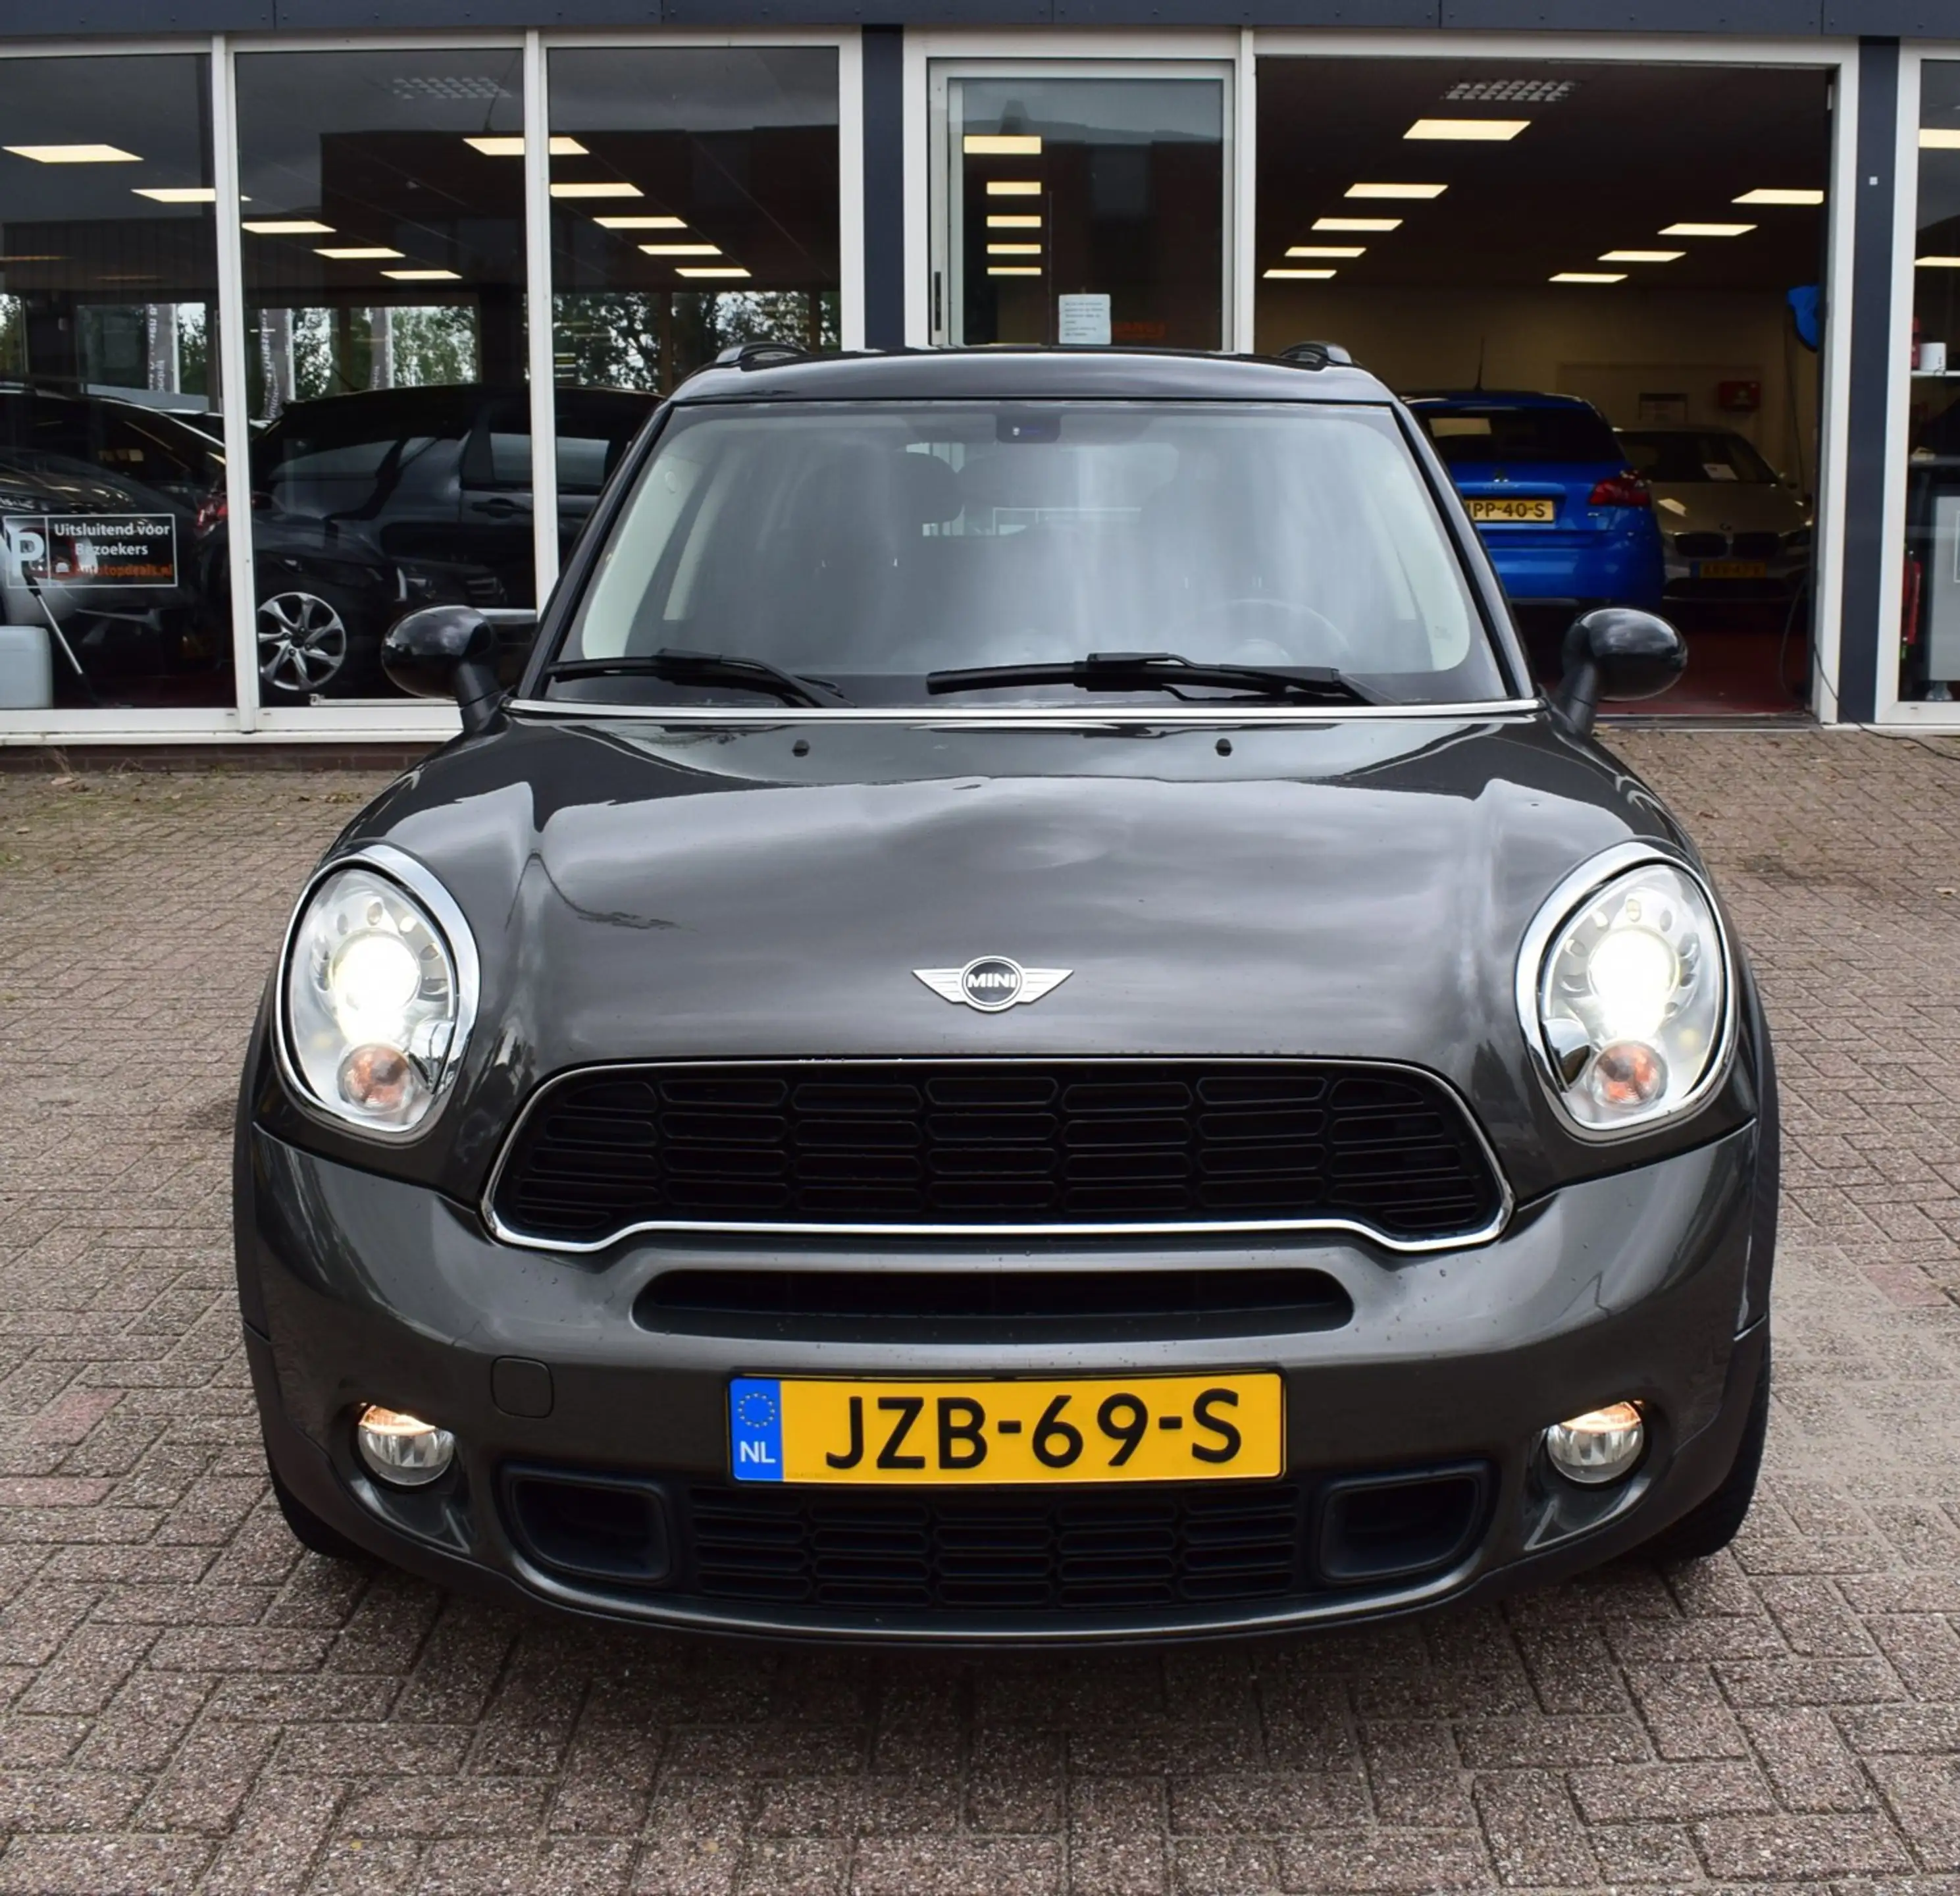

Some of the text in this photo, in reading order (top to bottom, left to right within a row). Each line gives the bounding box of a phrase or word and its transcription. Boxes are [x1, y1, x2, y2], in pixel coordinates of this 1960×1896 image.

[54, 523, 170, 537] Uitsluitend voor
[75, 542, 148, 556] Bezoekers
[967, 973, 1017, 988] MINI
[826, 1388, 1242, 1470] JZB-69-S
[740, 1440, 776, 1463] NL
